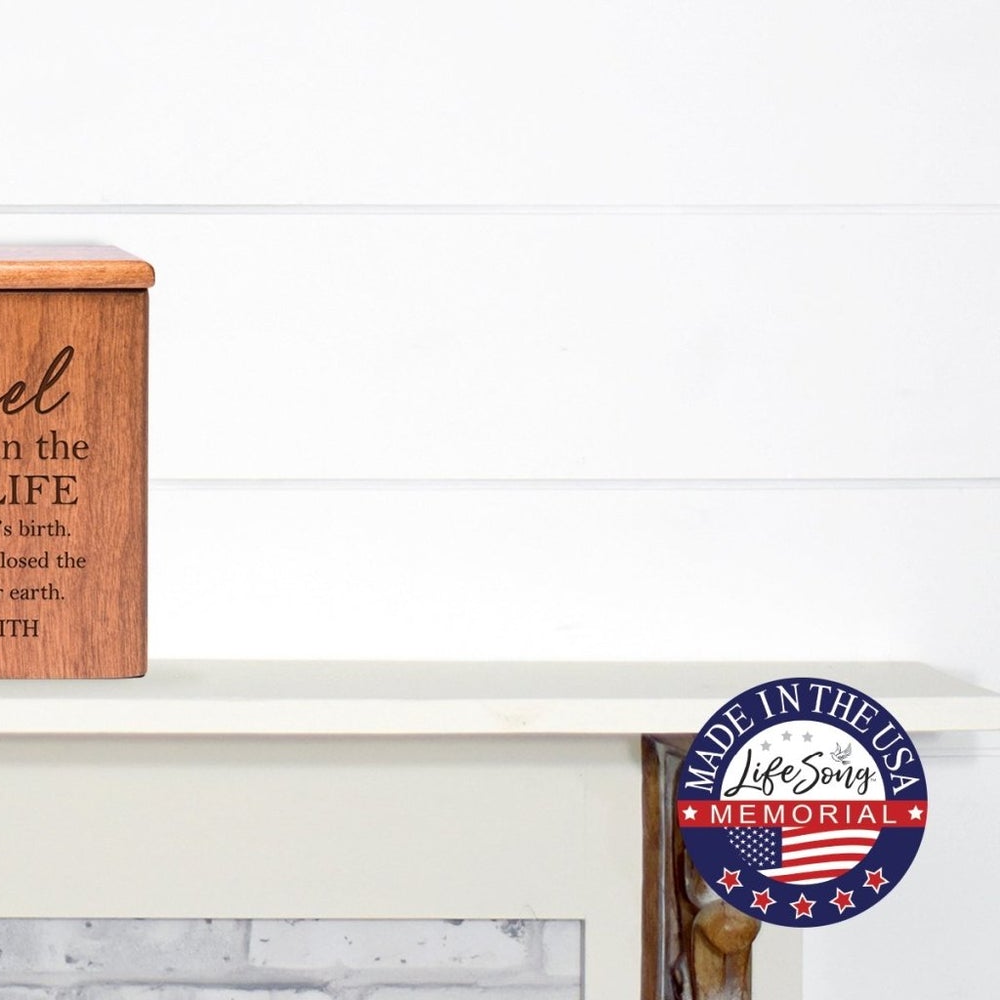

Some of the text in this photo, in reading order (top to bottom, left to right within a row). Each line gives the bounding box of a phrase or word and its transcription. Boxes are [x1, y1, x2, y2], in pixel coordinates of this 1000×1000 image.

[36, 430, 89, 460] the
[18, 520, 71, 537] birth.
[56, 551, 87, 569] the
[9, 583, 65, 601] earth.
